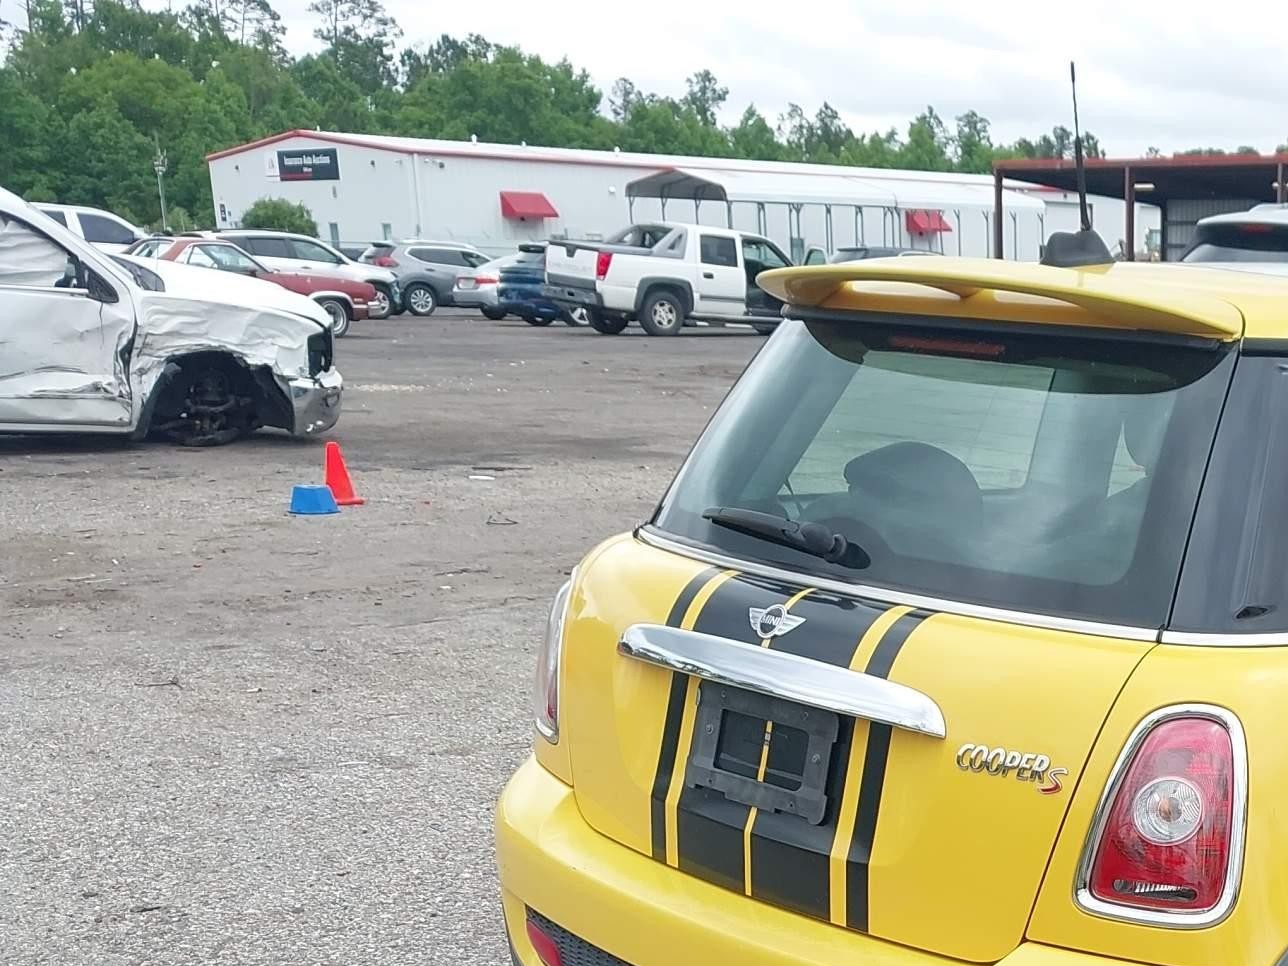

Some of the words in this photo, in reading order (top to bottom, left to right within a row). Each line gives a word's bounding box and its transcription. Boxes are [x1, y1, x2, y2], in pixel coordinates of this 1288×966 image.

[760, 613, 782, 627] MINI
[956, 743, 1050, 783] COOPER
[1038, 767, 1068, 794] S
